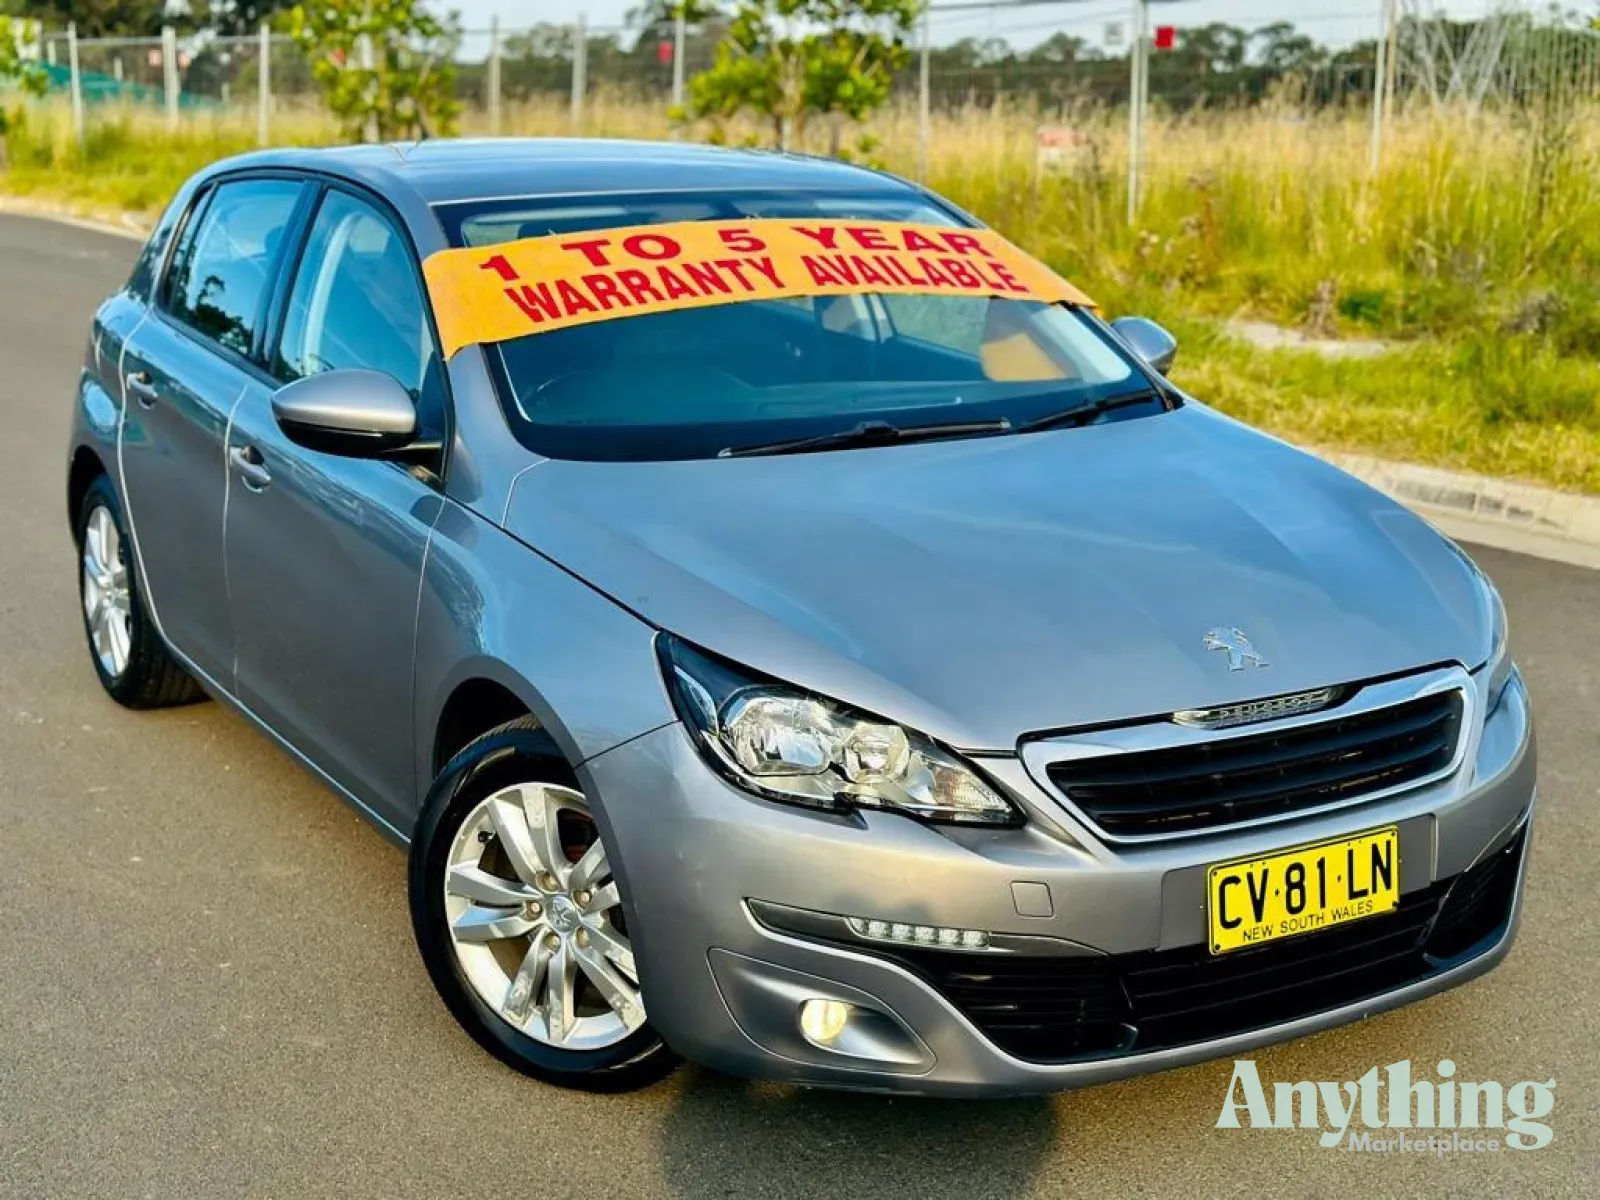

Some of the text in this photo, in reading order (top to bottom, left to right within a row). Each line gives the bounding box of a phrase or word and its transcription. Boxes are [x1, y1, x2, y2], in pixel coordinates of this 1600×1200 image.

[480, 227, 993, 281] 1 TO 5 YEAR
[504, 254, 1030, 323] WARRANTY AVAILABLE
[1243, 899, 1373, 942] NEW SOUTH WALES
